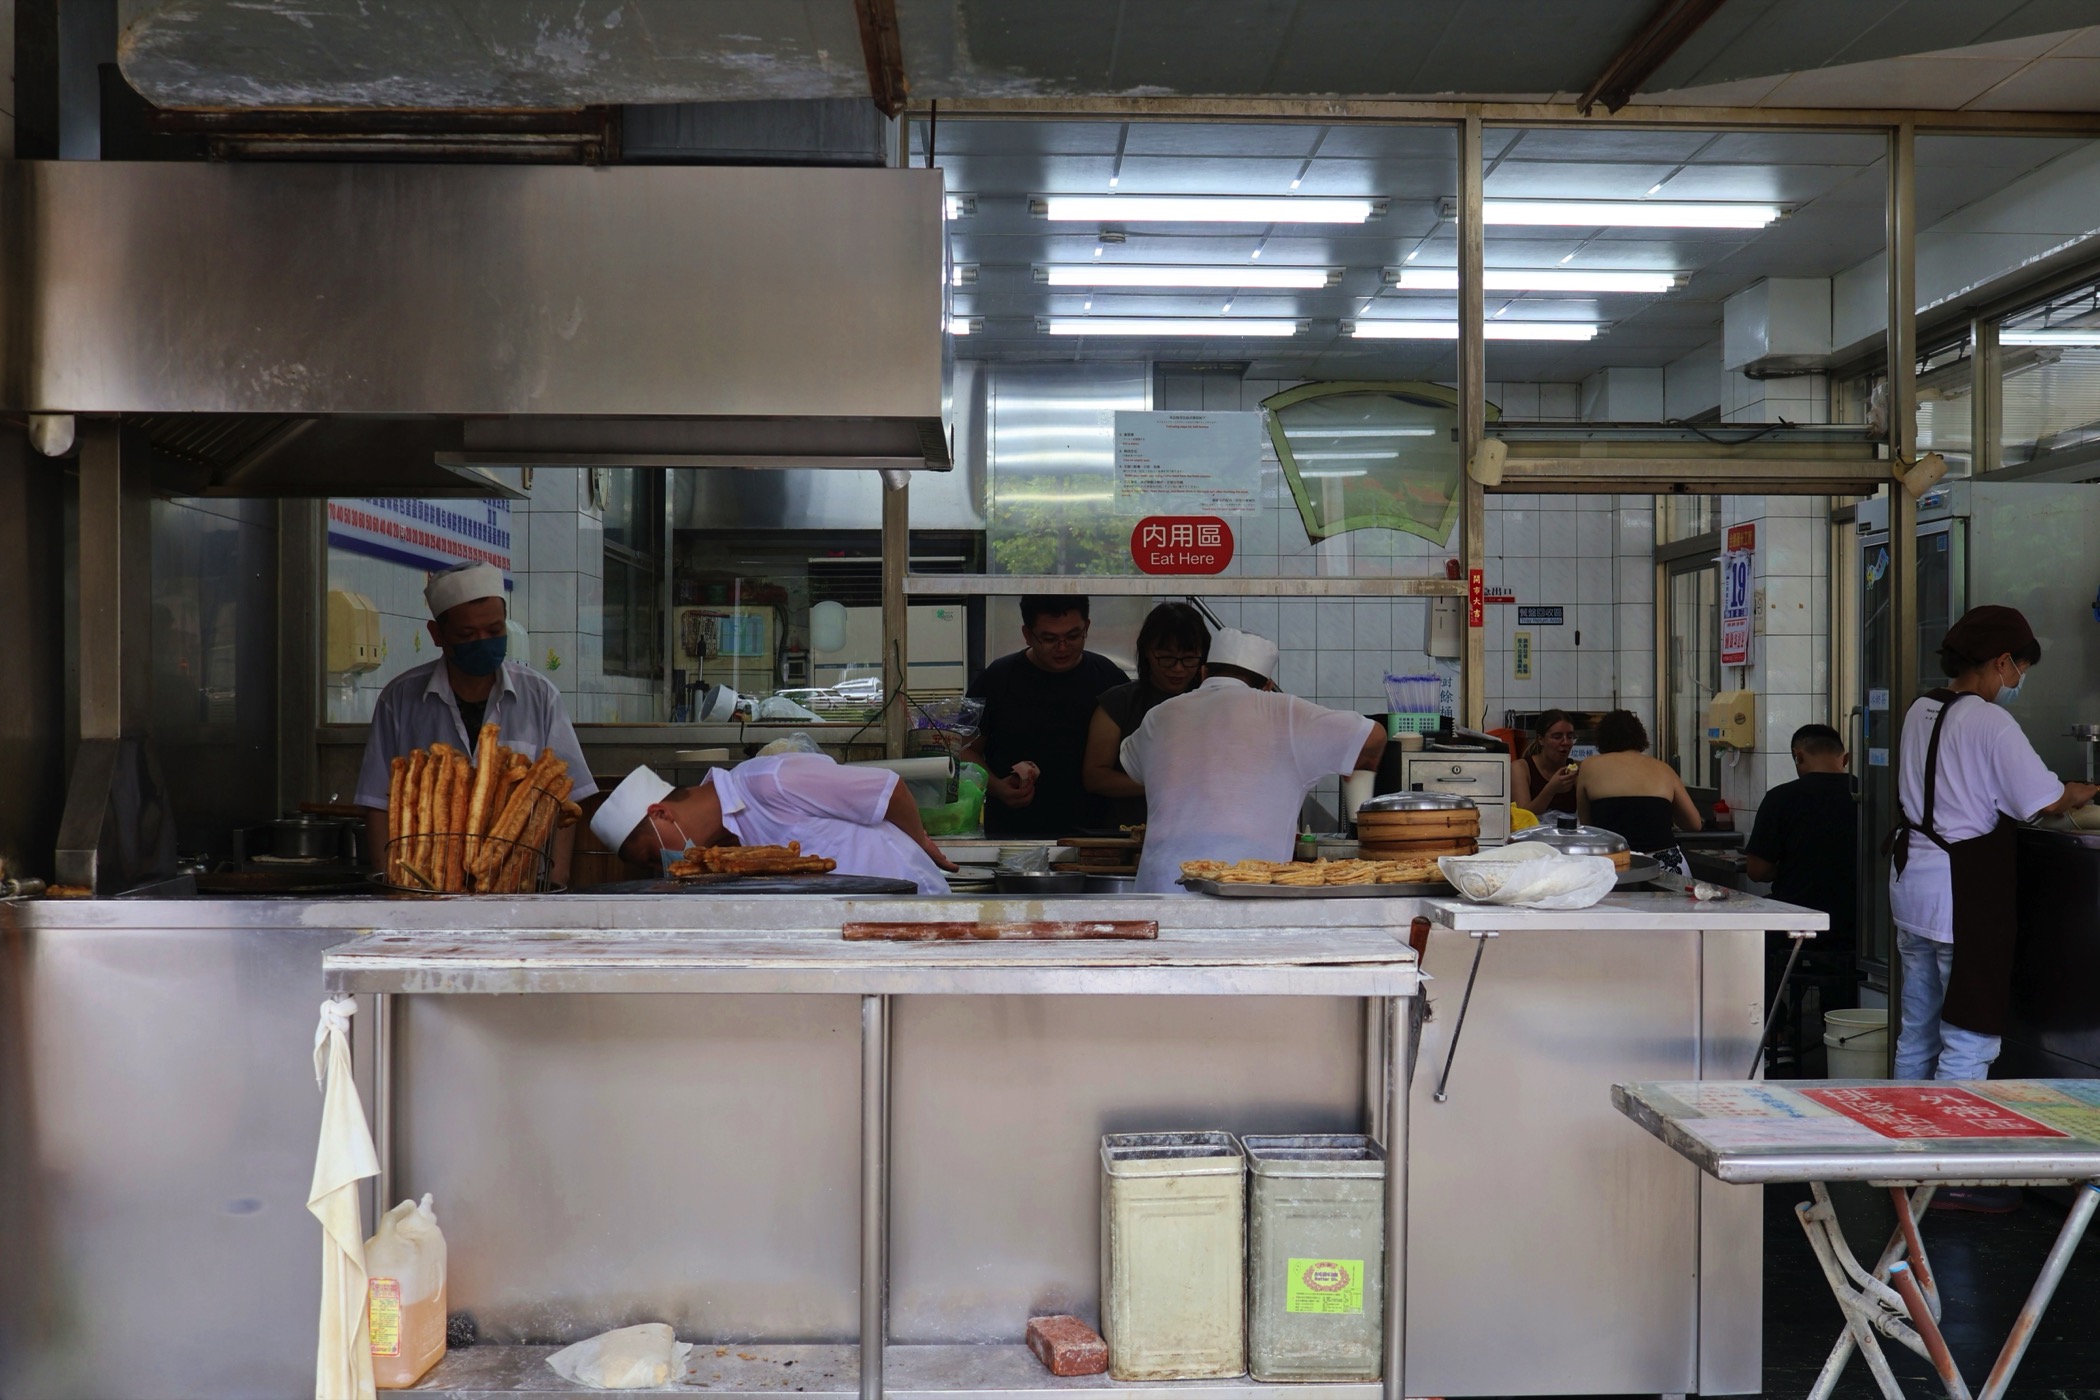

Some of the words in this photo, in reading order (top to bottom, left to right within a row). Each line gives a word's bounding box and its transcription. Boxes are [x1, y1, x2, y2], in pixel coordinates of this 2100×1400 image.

[329, 503, 335, 520] 70
[336, 506, 343, 523] 40
[344, 508, 350, 525] 50
[351, 510, 357, 527] 30
[358, 512, 365, 529] 60
[365, 515, 372, 531] 50
[372, 517, 379, 533] 60
[379, 519, 385, 535] 40
[386, 521, 392, 537] 40
[393, 523, 398, 539] 20
[1143, 524, 1222, 548] 內用區
[1150, 552, 1174, 565] Eat
[1179, 552, 1215, 565] Here
[1730, 562, 1746, 608] 19
[1520, 608, 1562, 617] 餐盤回收區
[1571, 749, 1593, 758] 垃圾桶
[1919, 1093, 2036, 1130] 外帶區
